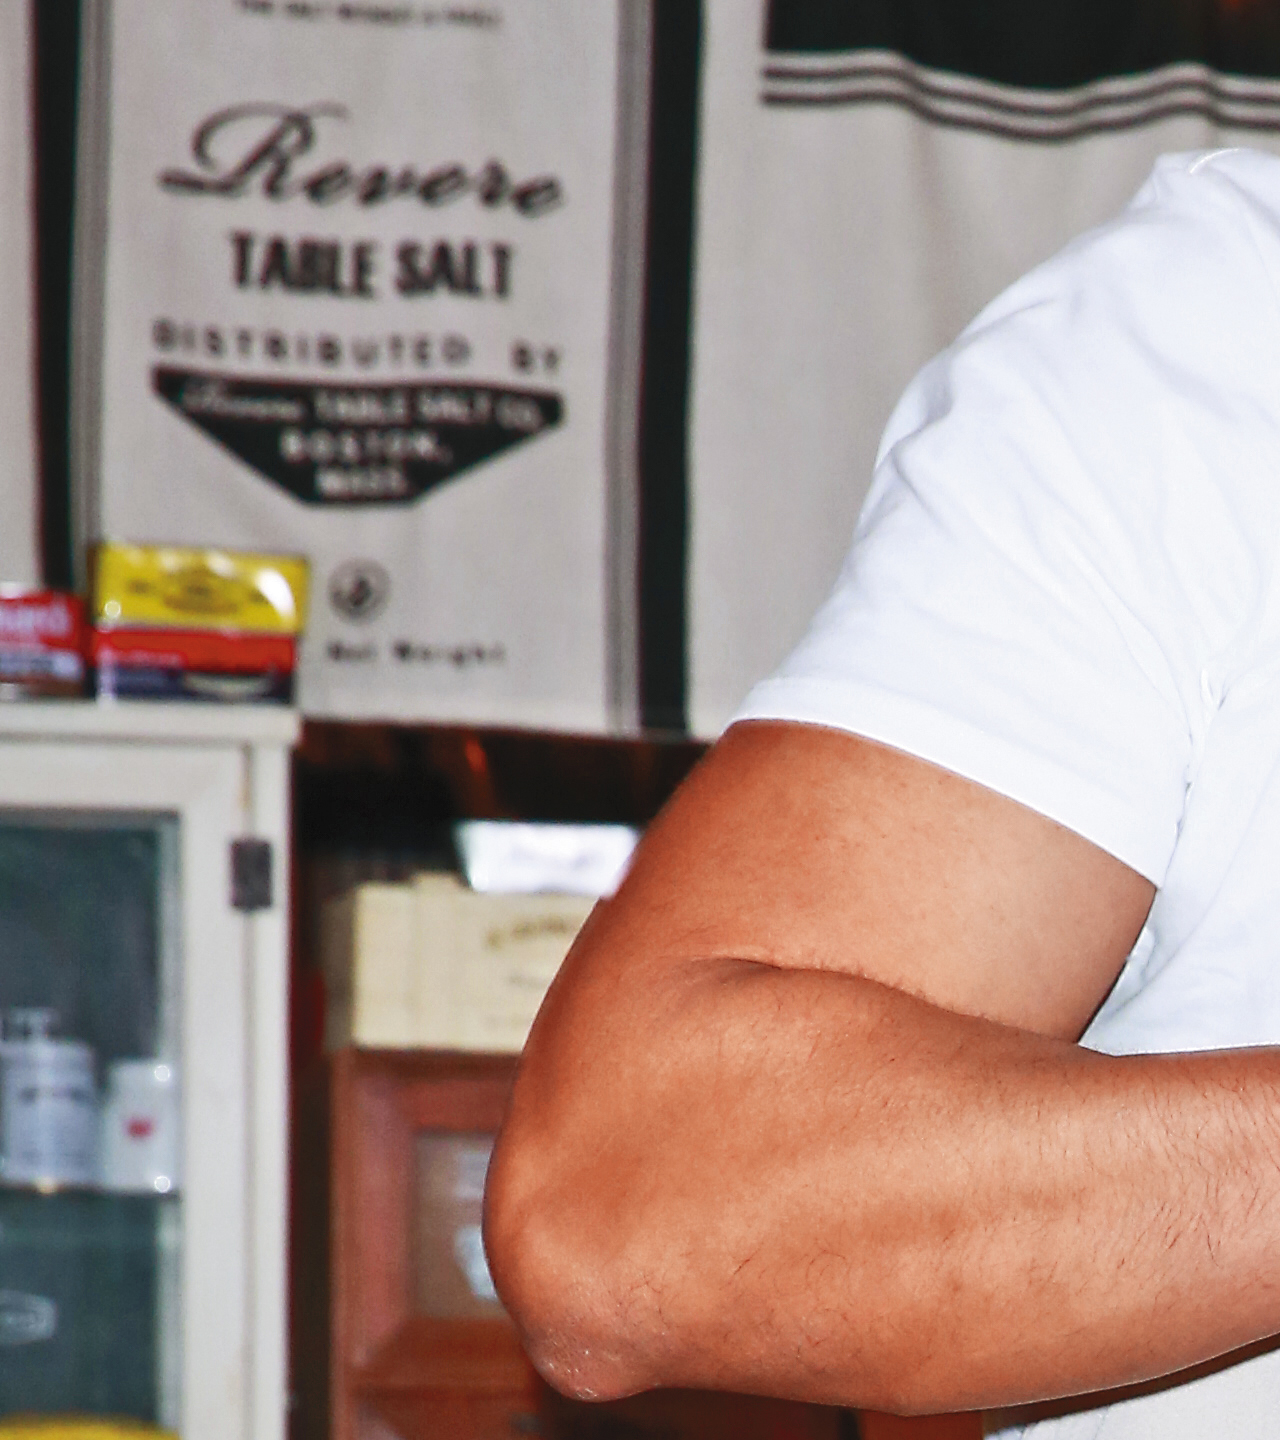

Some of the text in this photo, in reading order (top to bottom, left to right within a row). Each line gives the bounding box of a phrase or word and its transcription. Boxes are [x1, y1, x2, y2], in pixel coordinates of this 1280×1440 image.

[231, 230, 514, 302] TABLE SALT
[152, 317, 473, 368] DISTRIBUTED
